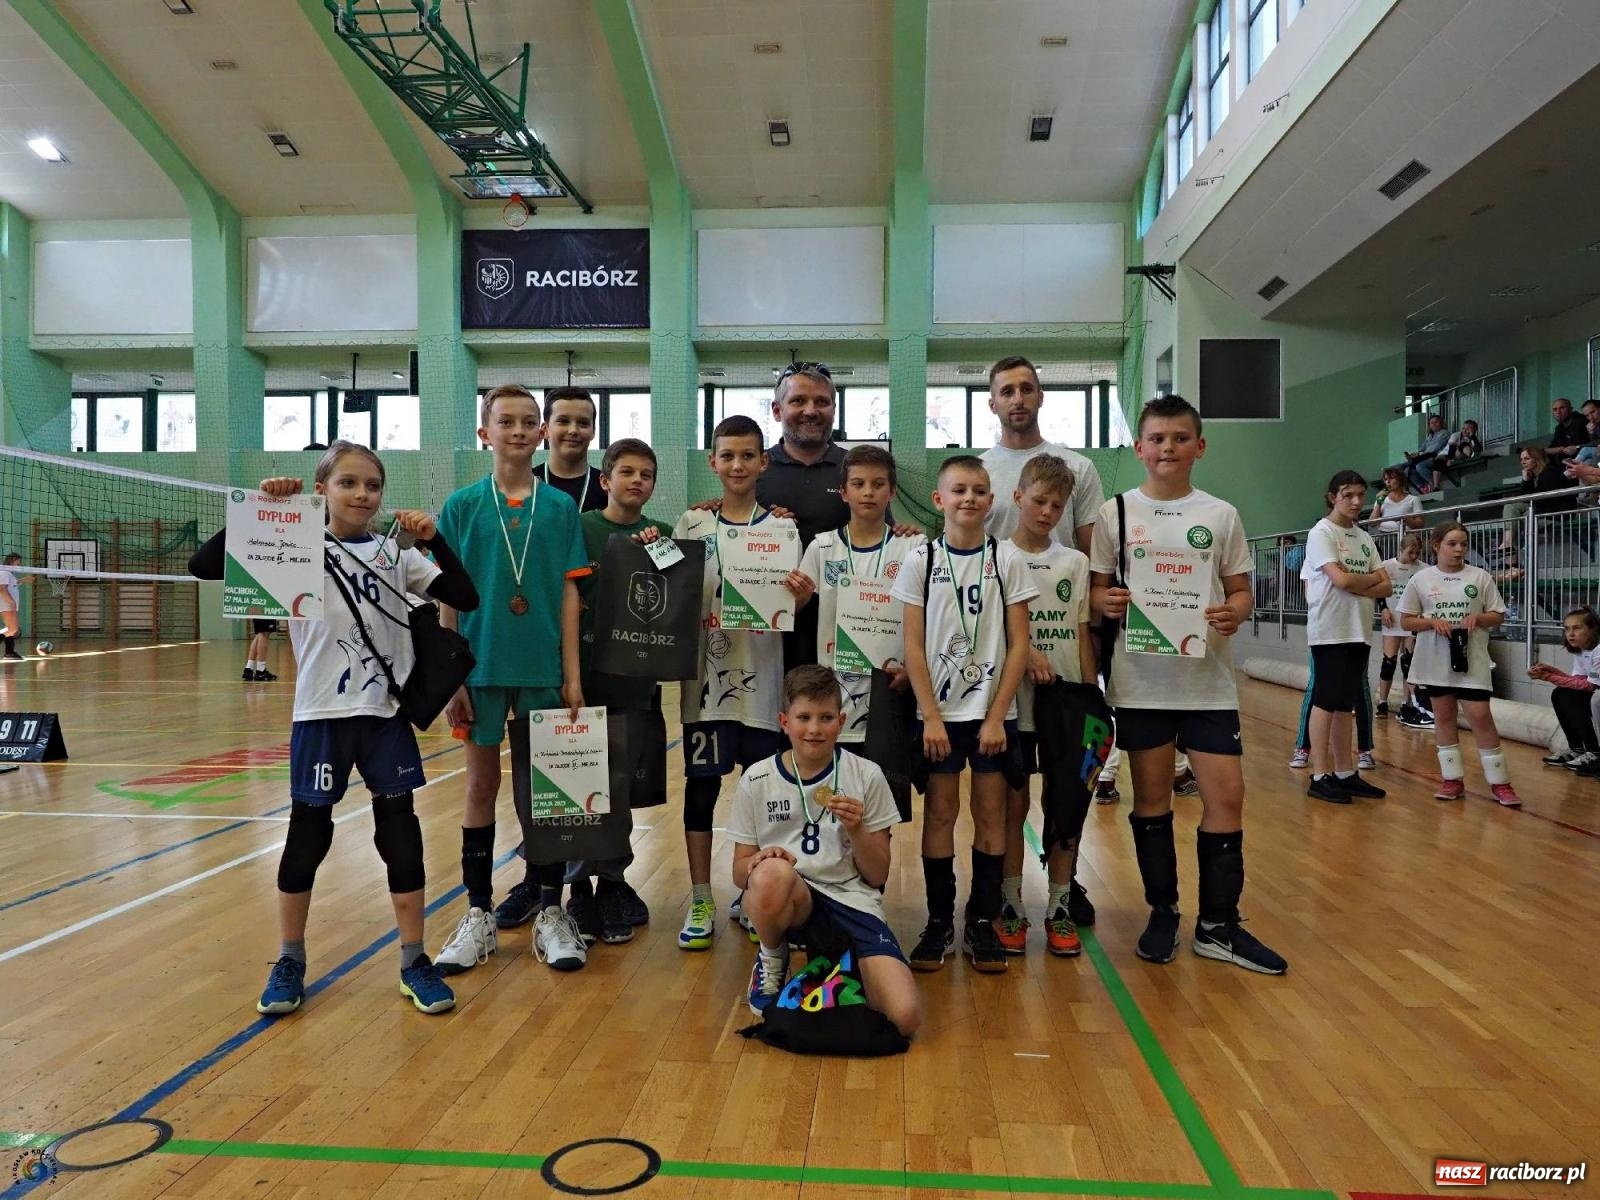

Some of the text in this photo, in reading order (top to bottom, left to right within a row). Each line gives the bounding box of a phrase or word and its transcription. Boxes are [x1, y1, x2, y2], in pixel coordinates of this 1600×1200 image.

[525, 265, 639, 287] RACIBÓRZ
[257, 509, 302, 524] DYPLOM
[747, 542, 780, 553] DYPLOM
[1155, 562, 1193, 575] DYPLOM
[350, 572, 381, 604] 16
[232, 596, 250, 604] MAJA
[859, 591, 891, 604] DYPLOM
[956, 584, 983, 616] 19
[223, 605, 248, 614] GRAMY
[263, 607, 286, 616] MAMY
[1435, 601, 1470, 609] GRAMY
[1028, 610, 1068, 622] RAMY
[611, 629, 677, 646] RACIBÓRZ
[1031, 643, 1055, 652] 023
[20, 720, 38, 740] 11
[554, 723, 589, 736] DYPLOM
[691, 730, 720, 765] 21
[313, 762, 334, 792] 16
[768, 812, 791, 823] RYBNIK
[801, 822, 820, 855] 8
